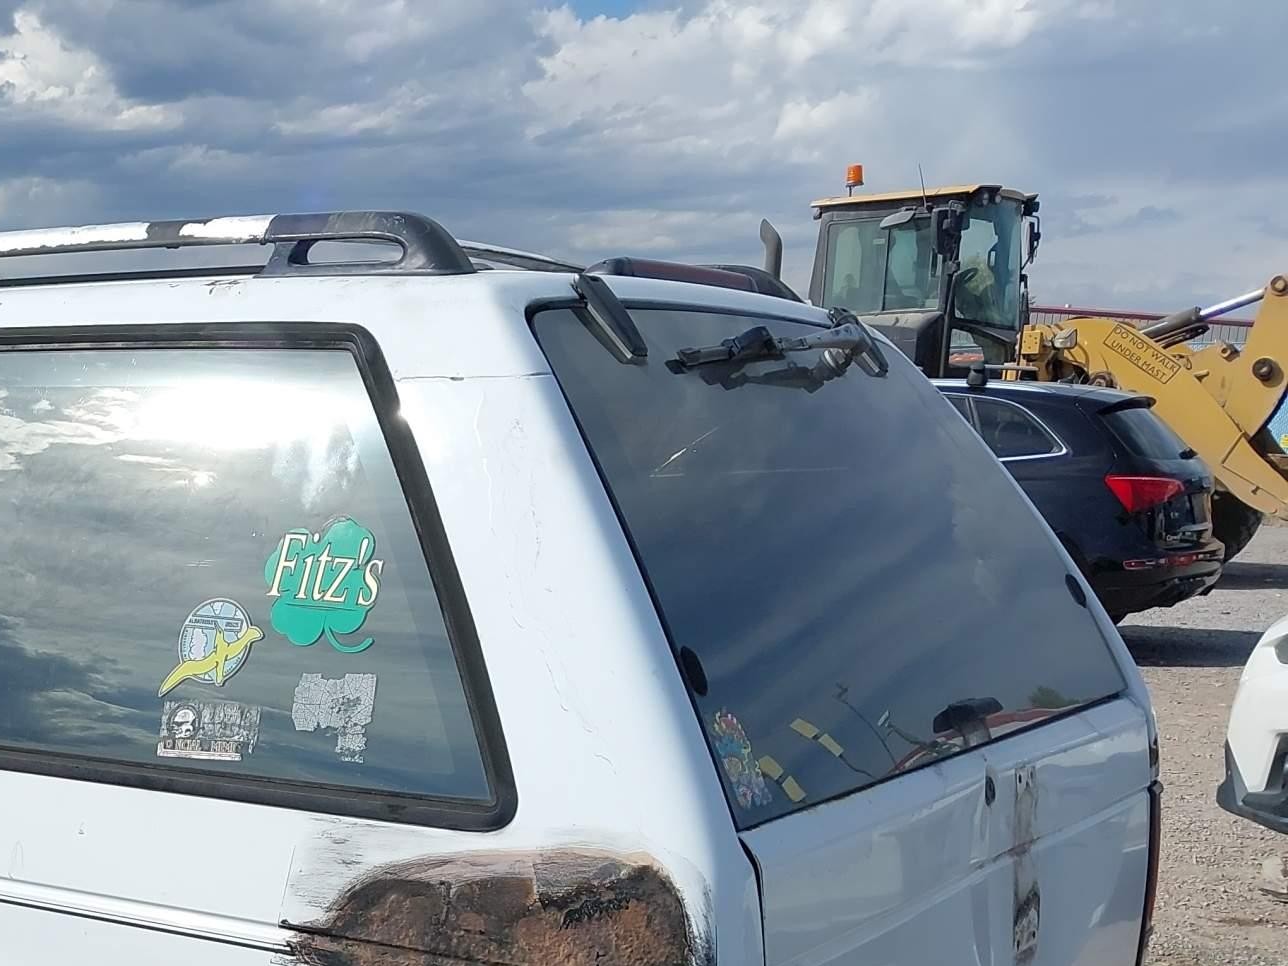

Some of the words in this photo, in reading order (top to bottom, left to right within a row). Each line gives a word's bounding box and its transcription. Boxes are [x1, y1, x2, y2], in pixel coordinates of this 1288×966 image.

[1111, 340, 1142, 363] UNDER
[1141, 360, 1168, 380] MAST
[1113, 326, 1129, 340] DO
[1129, 337, 1151, 353] NOT
[1151, 350, 1177, 373] WALK
[265, 532, 384, 607] Fitz's
